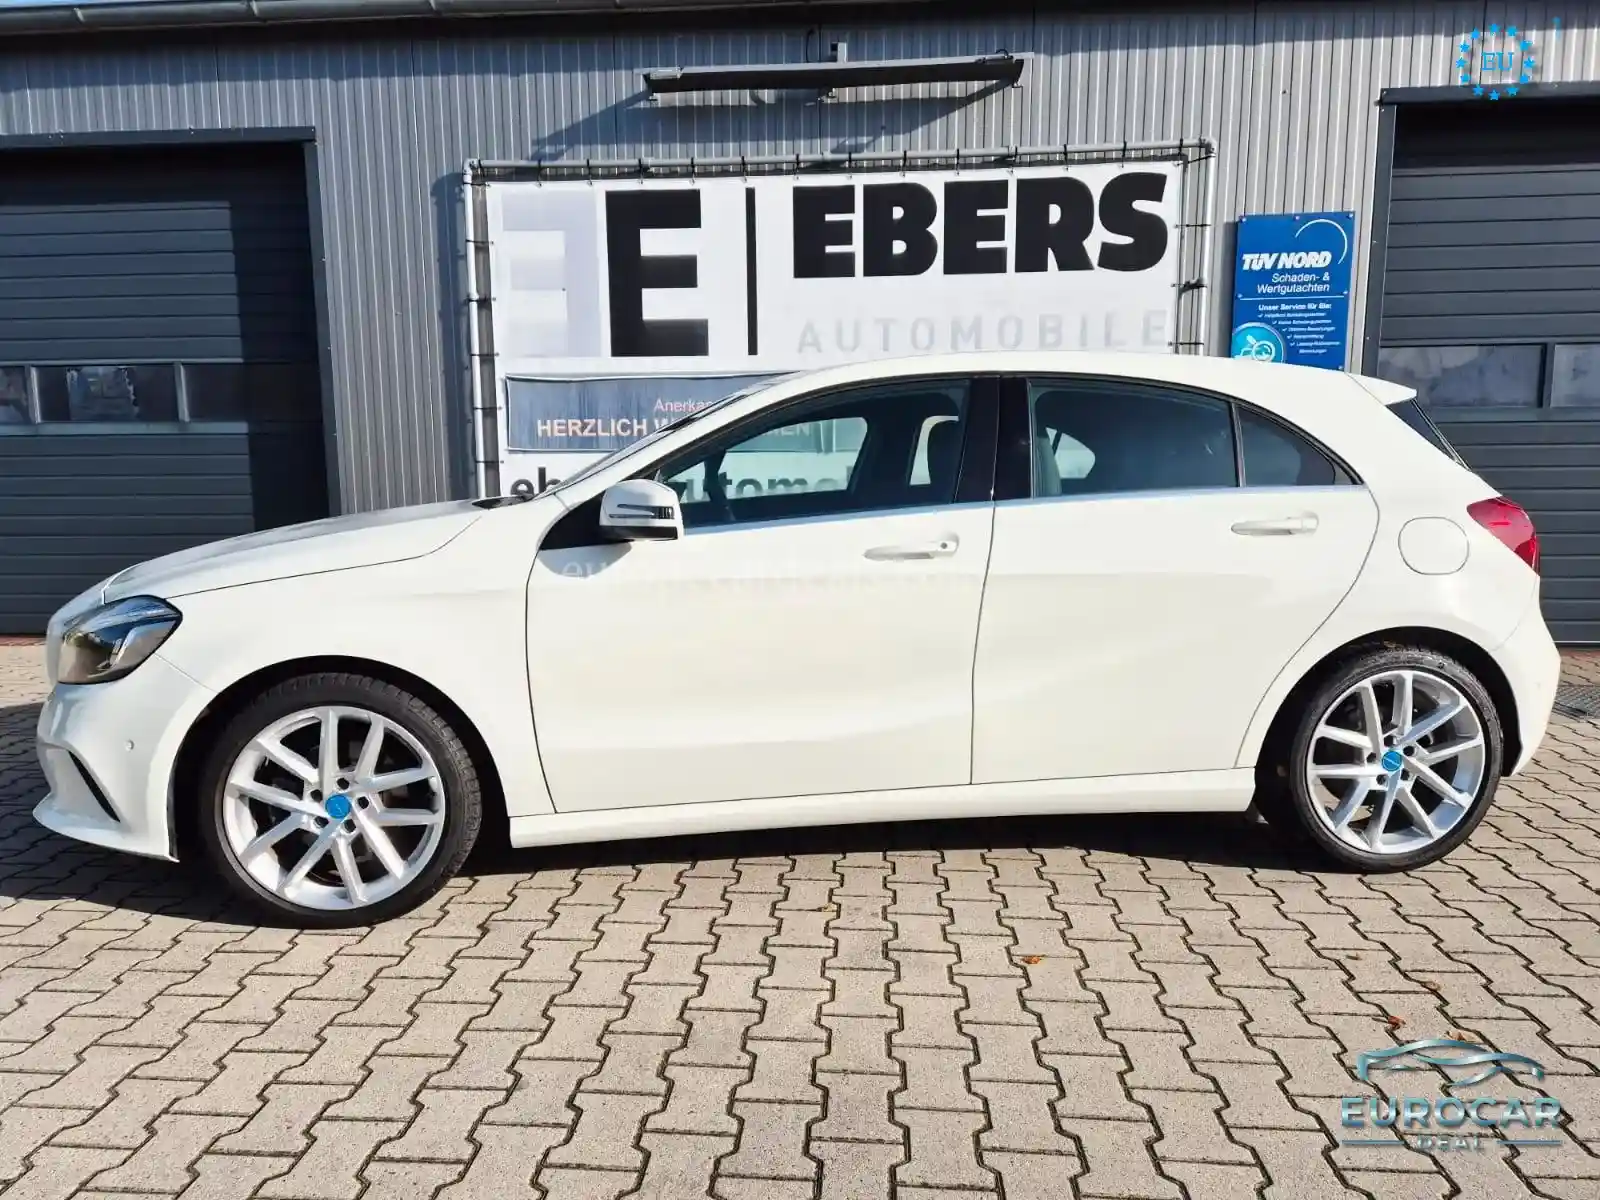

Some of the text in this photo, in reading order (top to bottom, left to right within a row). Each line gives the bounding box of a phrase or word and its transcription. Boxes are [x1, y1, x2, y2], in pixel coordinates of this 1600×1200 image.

[793, 172, 1168, 279] EBERS
[1242, 251, 1332, 271] TÜV NORD
[605, 188, 709, 357] E
[1271, 271, 1331, 283] Schaden- &
[1257, 283, 1330, 295] Wertgutachten
[796, 309, 1168, 353] AUTOMOBILE
[537, 418, 647, 438] HERZLICH
